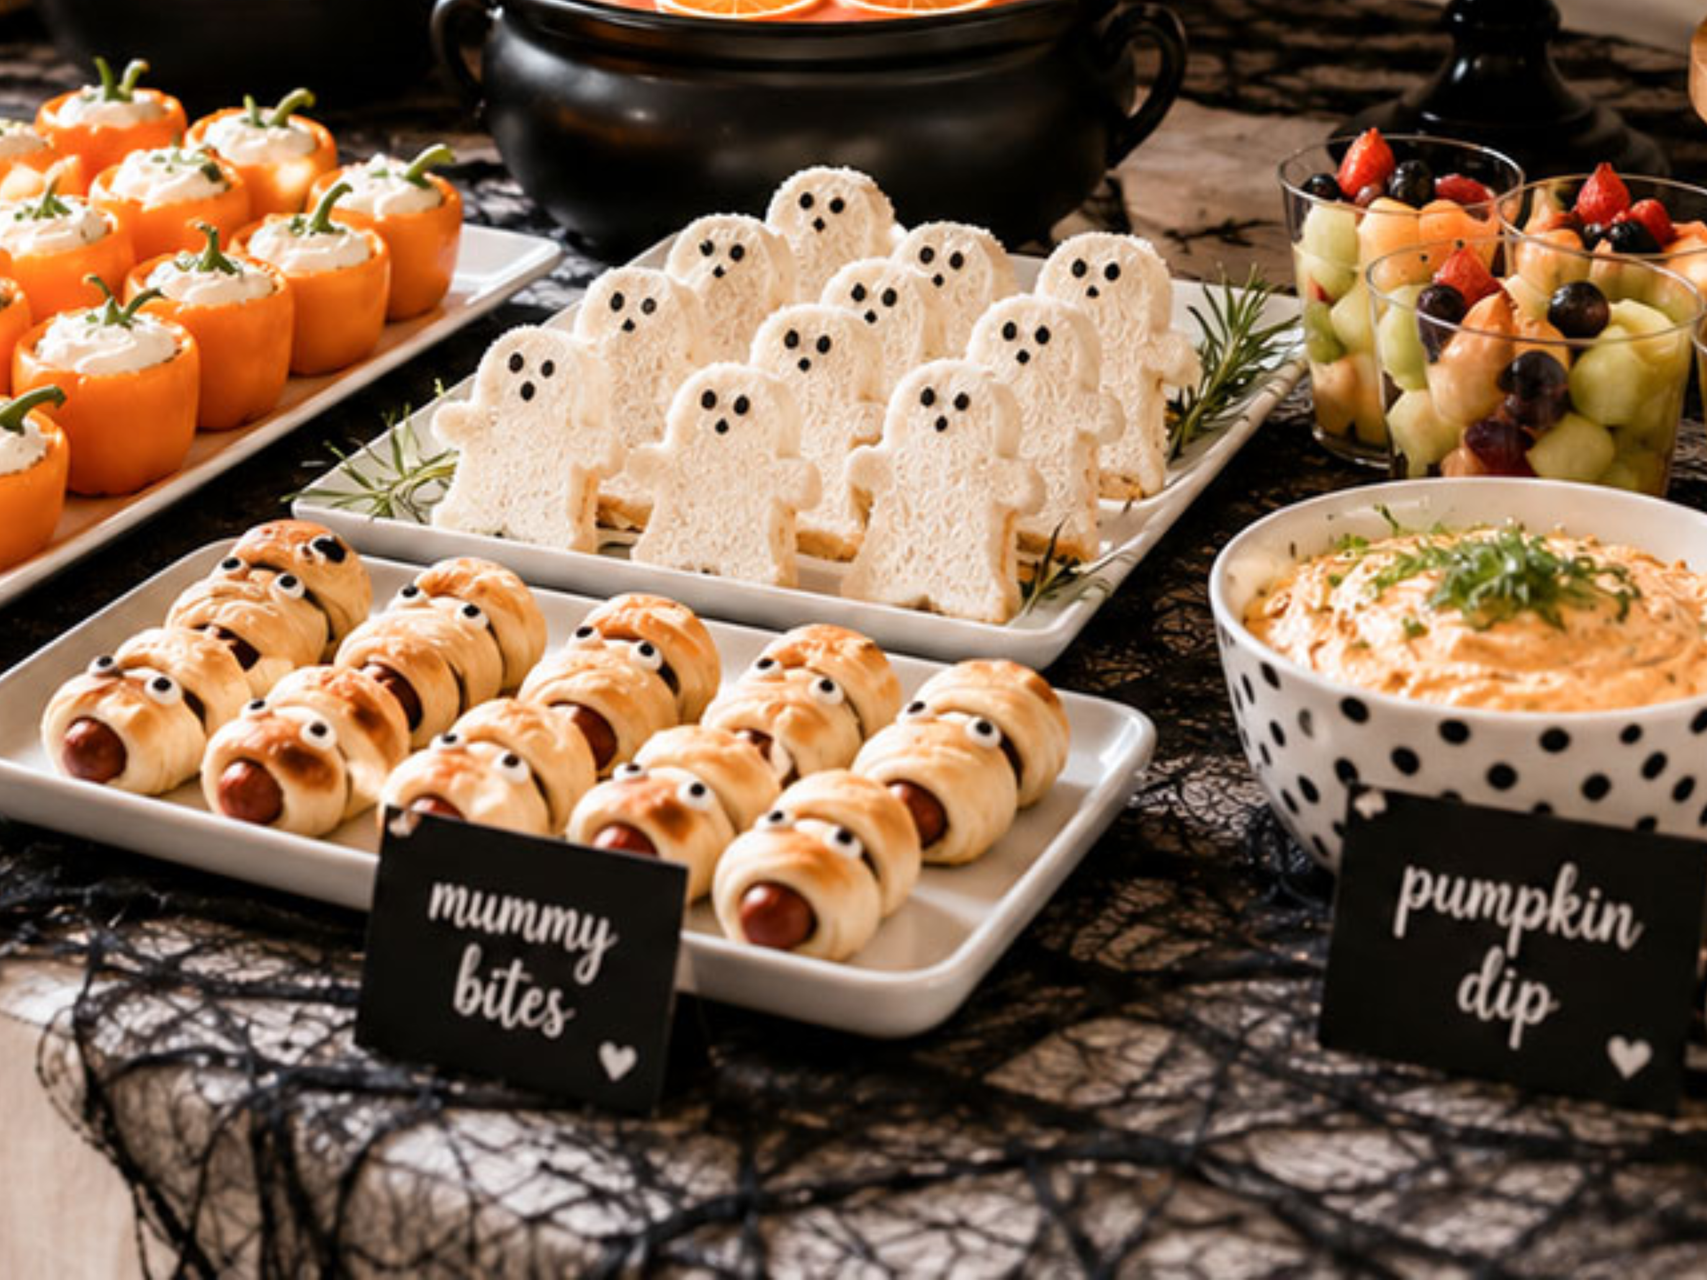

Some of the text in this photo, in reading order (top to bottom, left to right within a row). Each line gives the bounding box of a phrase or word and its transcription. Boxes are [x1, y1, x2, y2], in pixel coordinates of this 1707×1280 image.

[428, 882, 618, 985] mummy
[1393, 861, 1643, 958] pumpkin
[453, 942, 575, 1038] bites
[1457, 945, 1559, 1050] dip
